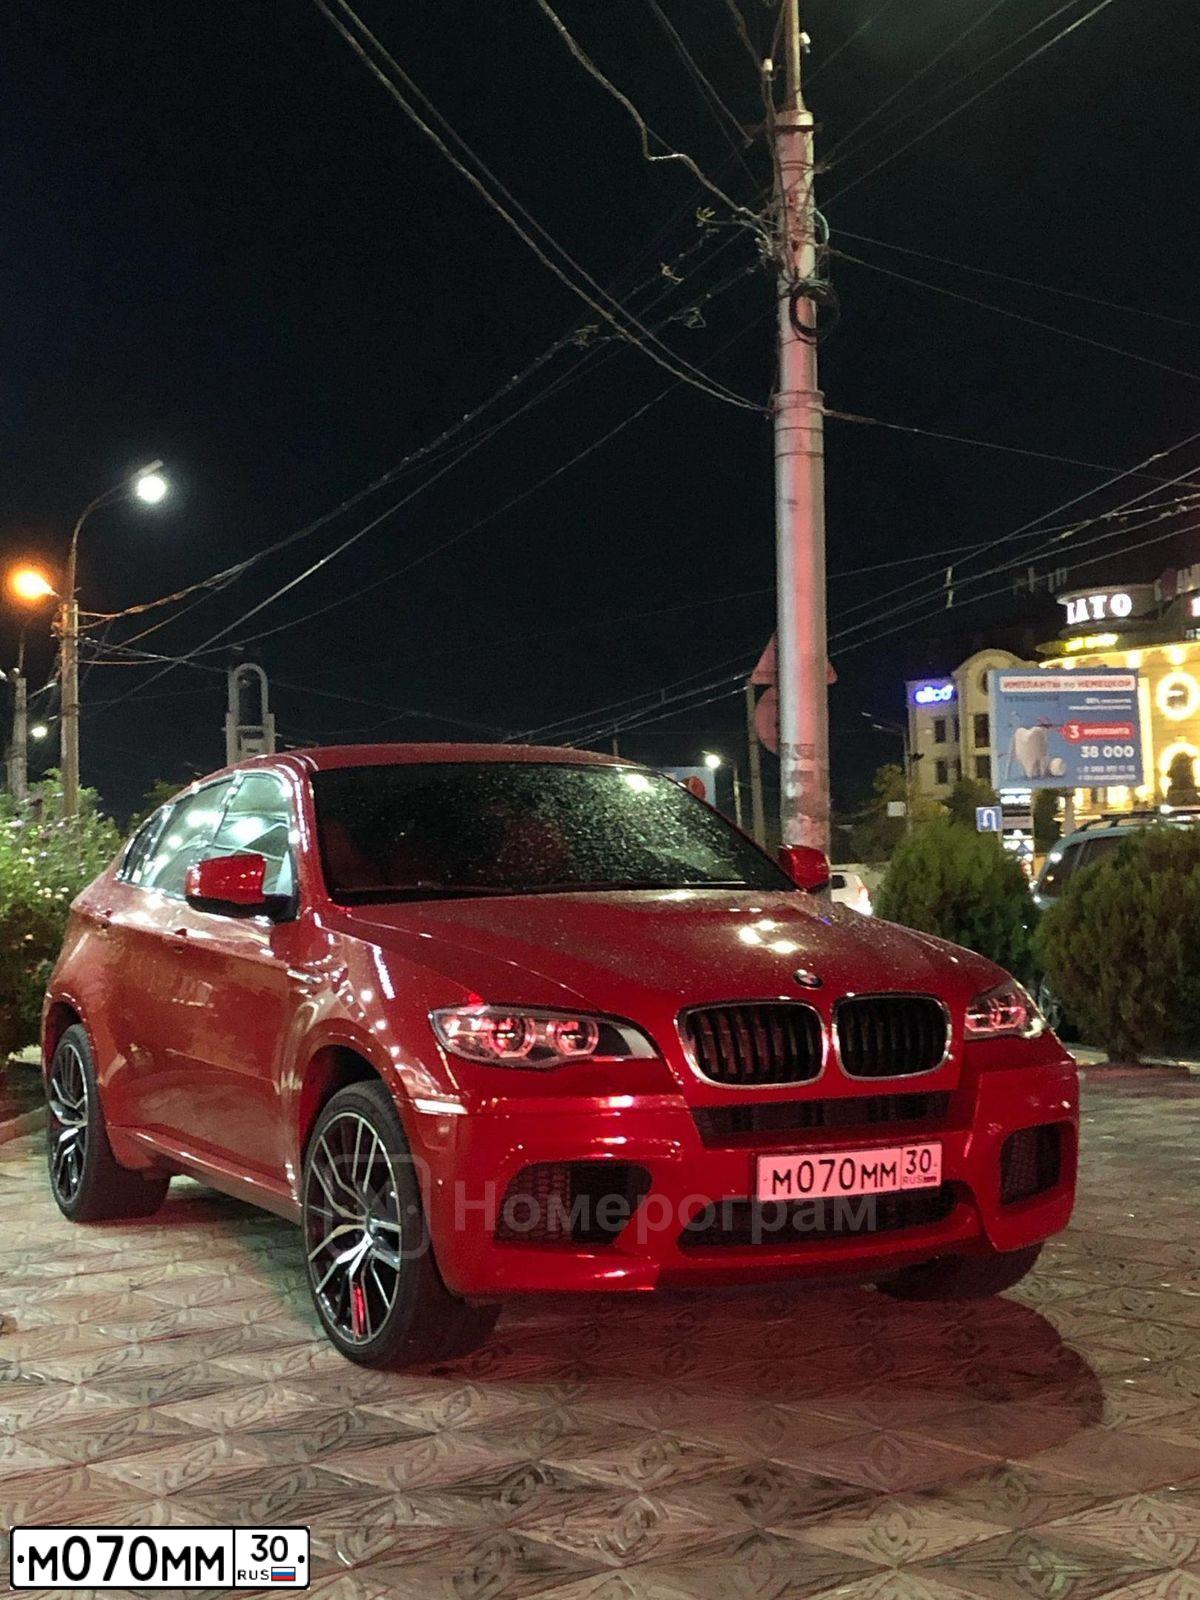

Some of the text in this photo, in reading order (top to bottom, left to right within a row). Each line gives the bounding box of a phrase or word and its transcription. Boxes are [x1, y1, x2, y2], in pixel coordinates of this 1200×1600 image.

[1068, 724, 1080, 739] 3
[1080, 745, 1135, 759] 38 000
[771, 1148, 932, 1195] М070ММ 30
[902, 1175, 924, 1185] RUS
